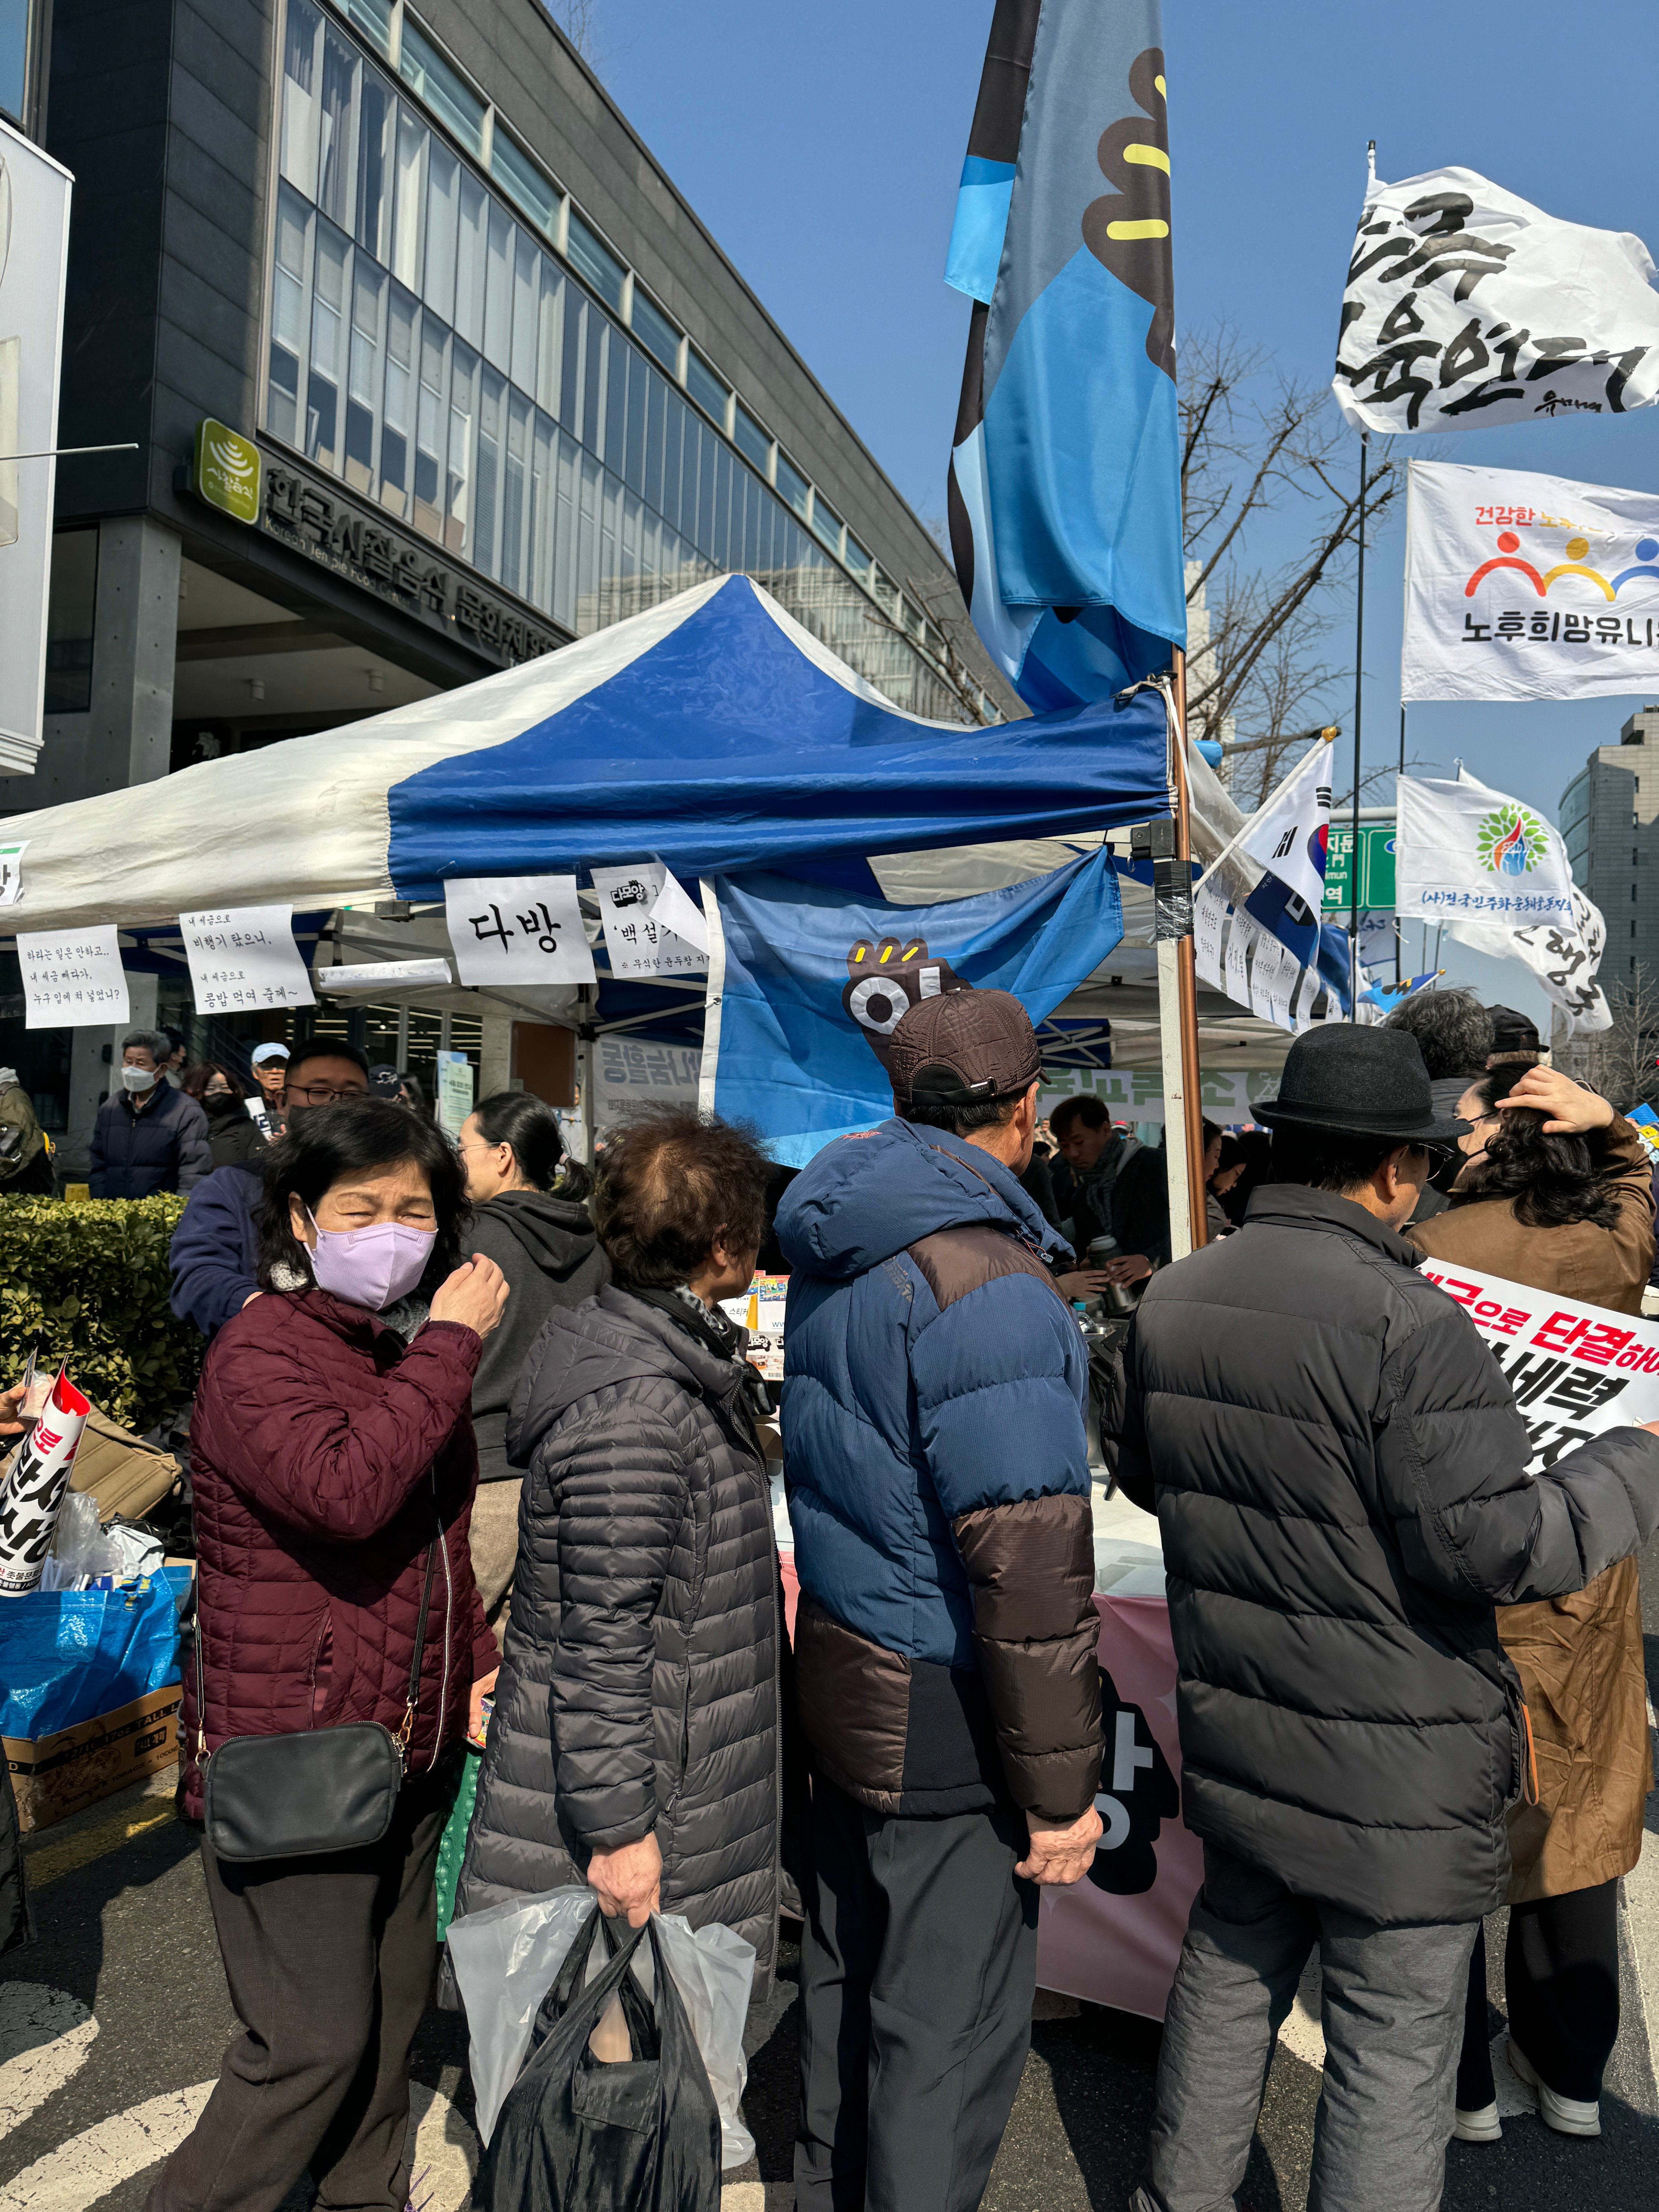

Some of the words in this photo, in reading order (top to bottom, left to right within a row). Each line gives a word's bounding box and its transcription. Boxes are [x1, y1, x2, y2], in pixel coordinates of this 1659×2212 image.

[1475, 506, 1536, 527] 건강한
[264, 515, 306, 551] Korean
[310, 542, 347, 574] Temple
[350, 564, 376, 590] Food
[266, 467, 450, 613] 한국사찰음식
[456, 585, 562, 660] 문화체험
[611, 884, 644, 902] 다모앙
[1325, 885, 1343, 905] 역
[189, 916, 195, 927] 내
[199, 914, 231, 926] 세금으로
[468, 902, 561, 954] 다방
[193, 934, 227, 950] 비행기
[27, 949, 52, 961] 하라는
[56, 947, 72, 960] 일은
[76, 945, 109, 958] 안하고..
[633, 957, 661, 969] 무식한
[665, 955, 692, 967] 윤두창
[30, 971, 38, 983] 내
[42, 970, 58, 982] 세금
[201, 973, 208, 984] 내
[212, 971, 245, 982] 세금으로
[33, 993, 51, 1005] 누구
[54, 991, 70, 1004] 입에
[87, 988, 119, 1003] 넣었니?
[204, 991, 228, 1008] 콩밥
[1426, 1271, 1532, 1336] 으로
[136, 1710, 167, 1728] TALL
